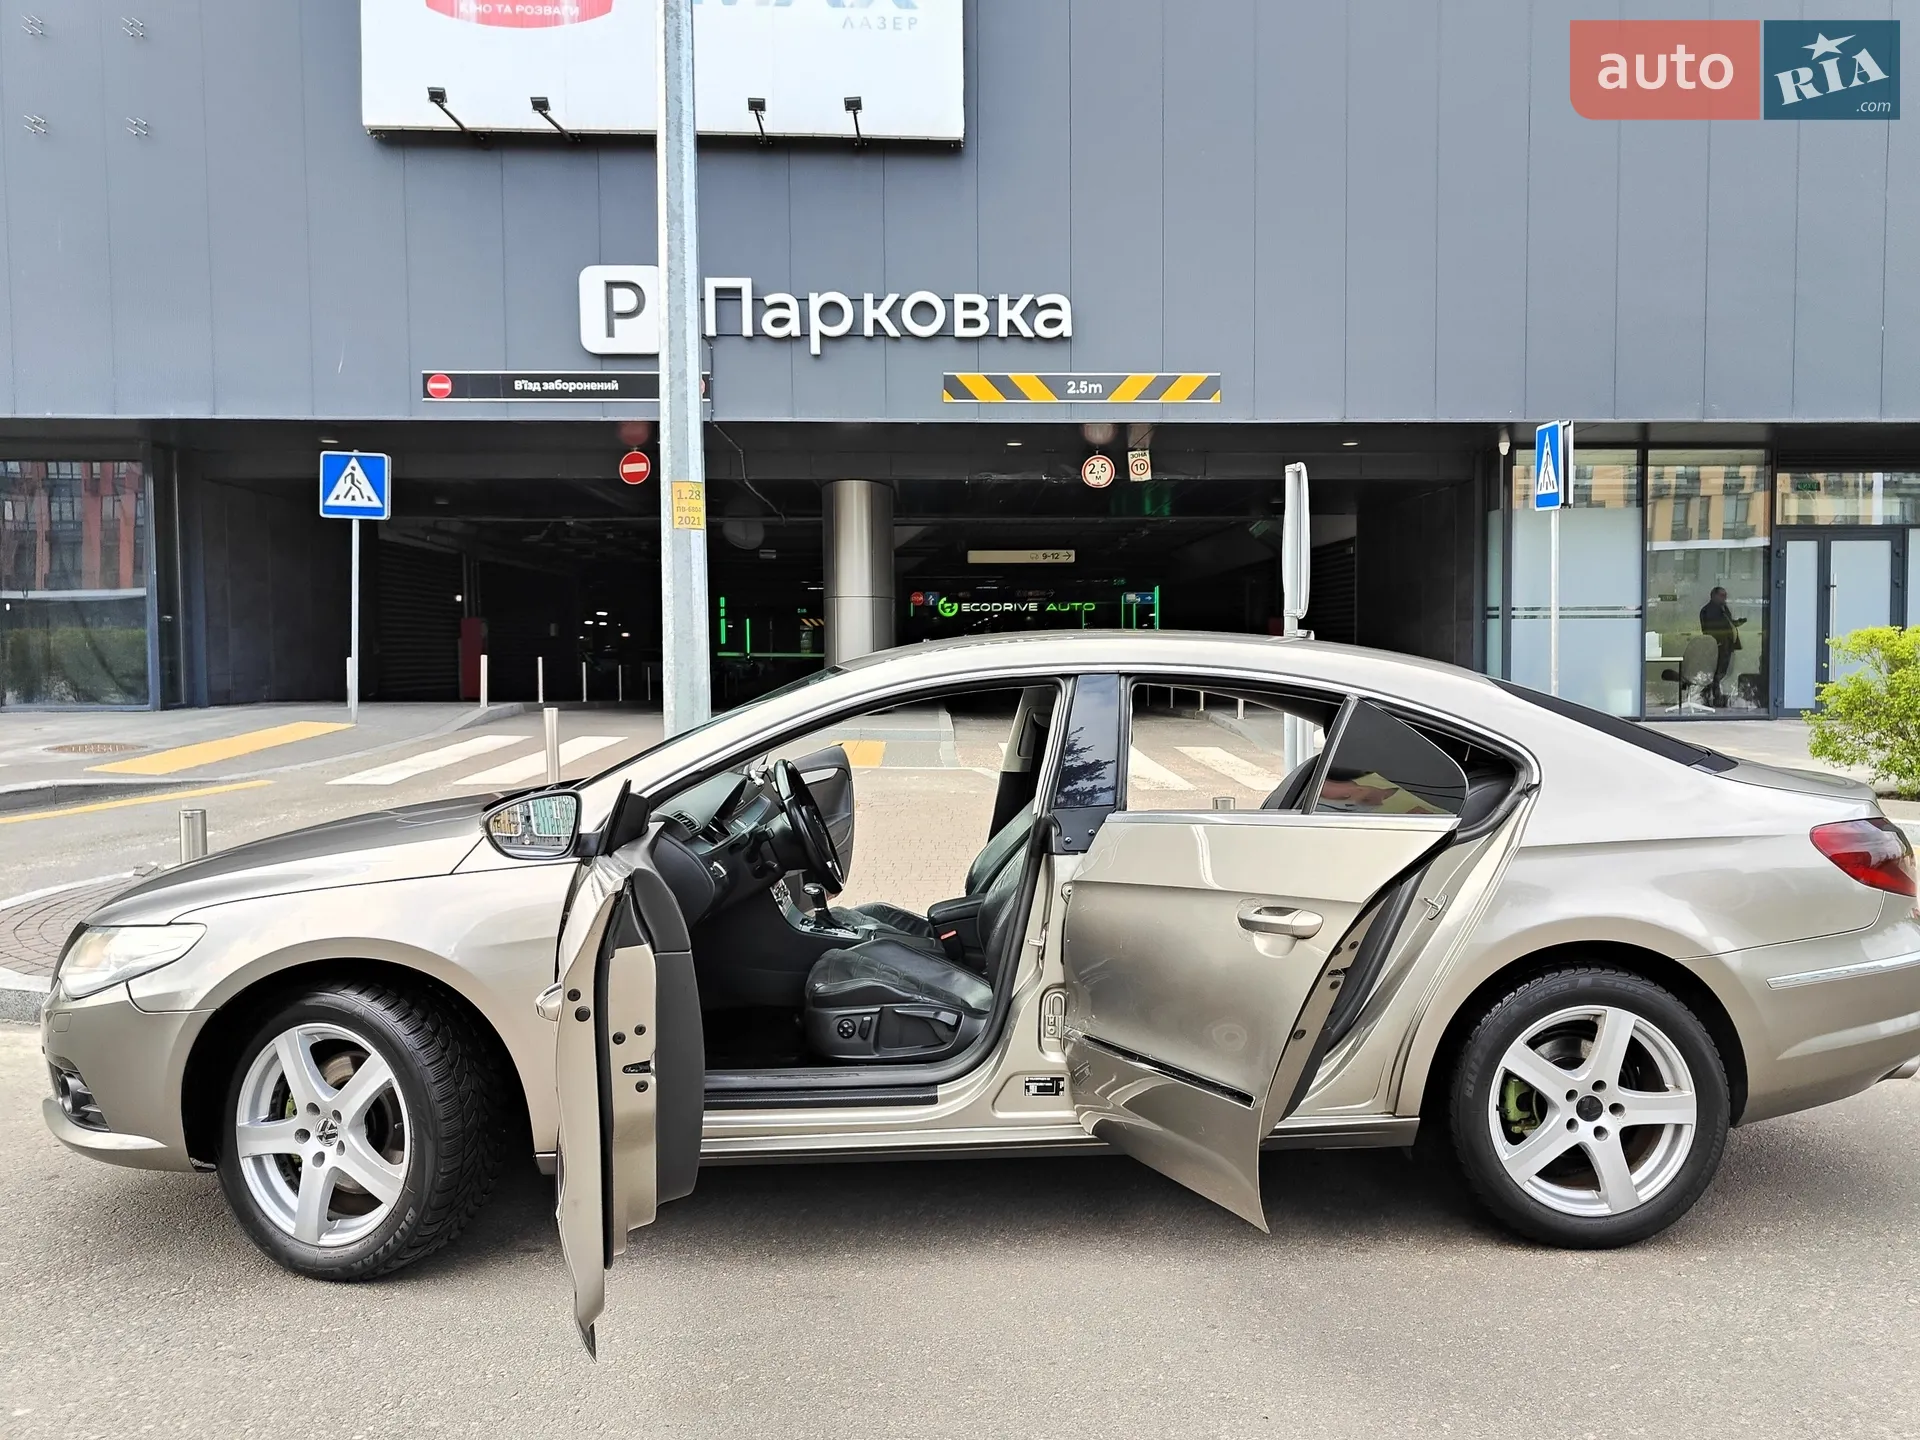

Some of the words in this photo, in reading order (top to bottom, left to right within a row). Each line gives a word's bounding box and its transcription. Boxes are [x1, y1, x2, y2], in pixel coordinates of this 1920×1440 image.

[496, 4, 513, 14] ТА
[704, 277, 1073, 356] Парковка
[542, 378, 619, 393] заборонений
[1066, 380, 1103, 394] 2.5m
[1088, 463, 1107, 475] 2,5
[1134, 463, 1146, 472] 10
[676, 489, 701, 501] 1.28
[677, 516, 702, 526] 2021
[1041, 552, 1060, 560] 9-12
[961, 602, 1038, 612] ECODRIVE
[1045, 602, 1096, 612] AUTO
